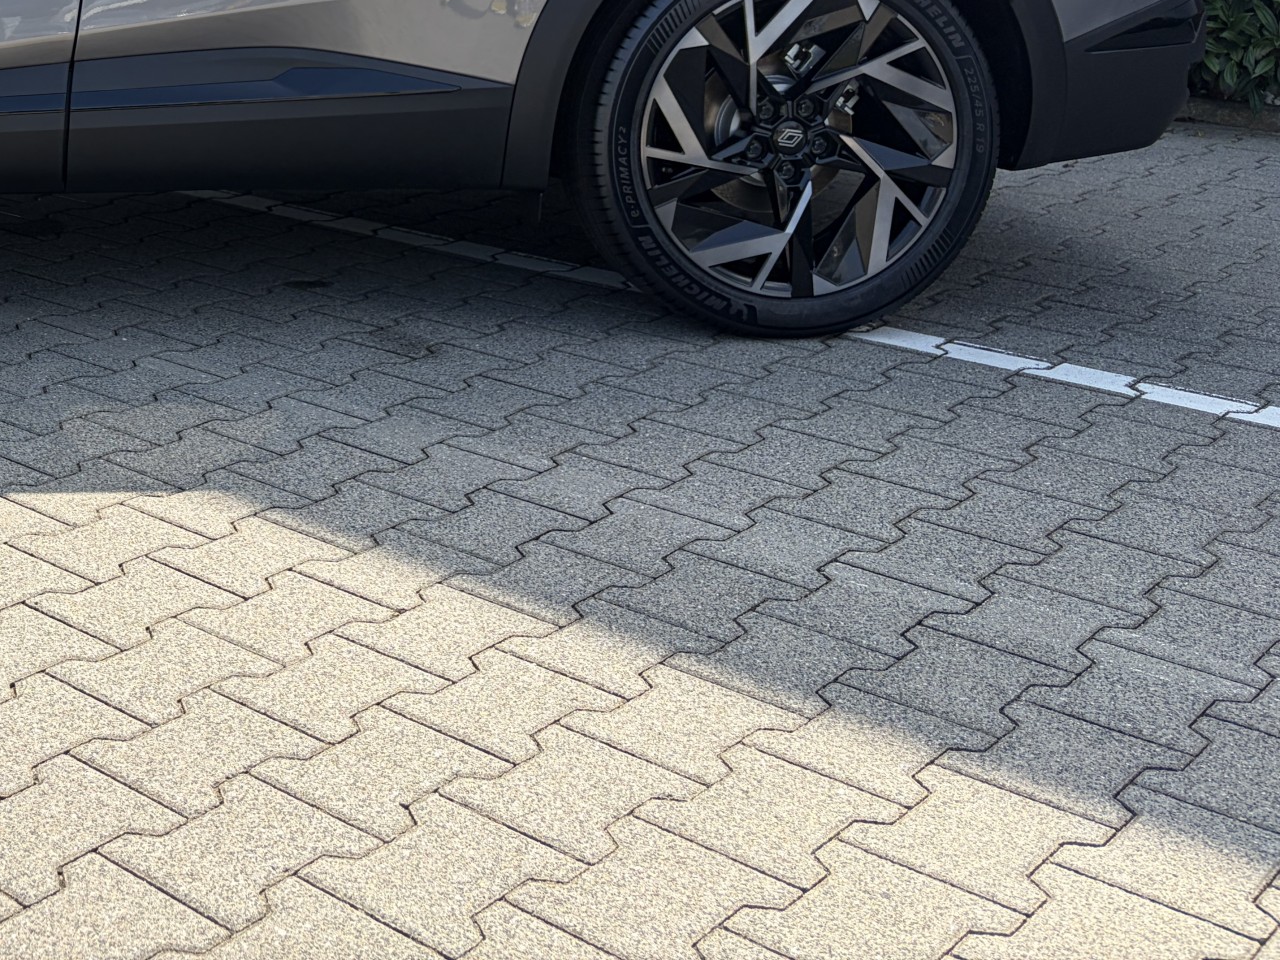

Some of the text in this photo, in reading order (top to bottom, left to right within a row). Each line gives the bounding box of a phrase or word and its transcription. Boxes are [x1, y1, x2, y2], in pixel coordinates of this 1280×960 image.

[964, 68, 984, 117] 225/45
[976, 122, 985, 132] R
[976, 140, 985, 152] 19
[638, 235, 728, 311] MICHELIN
